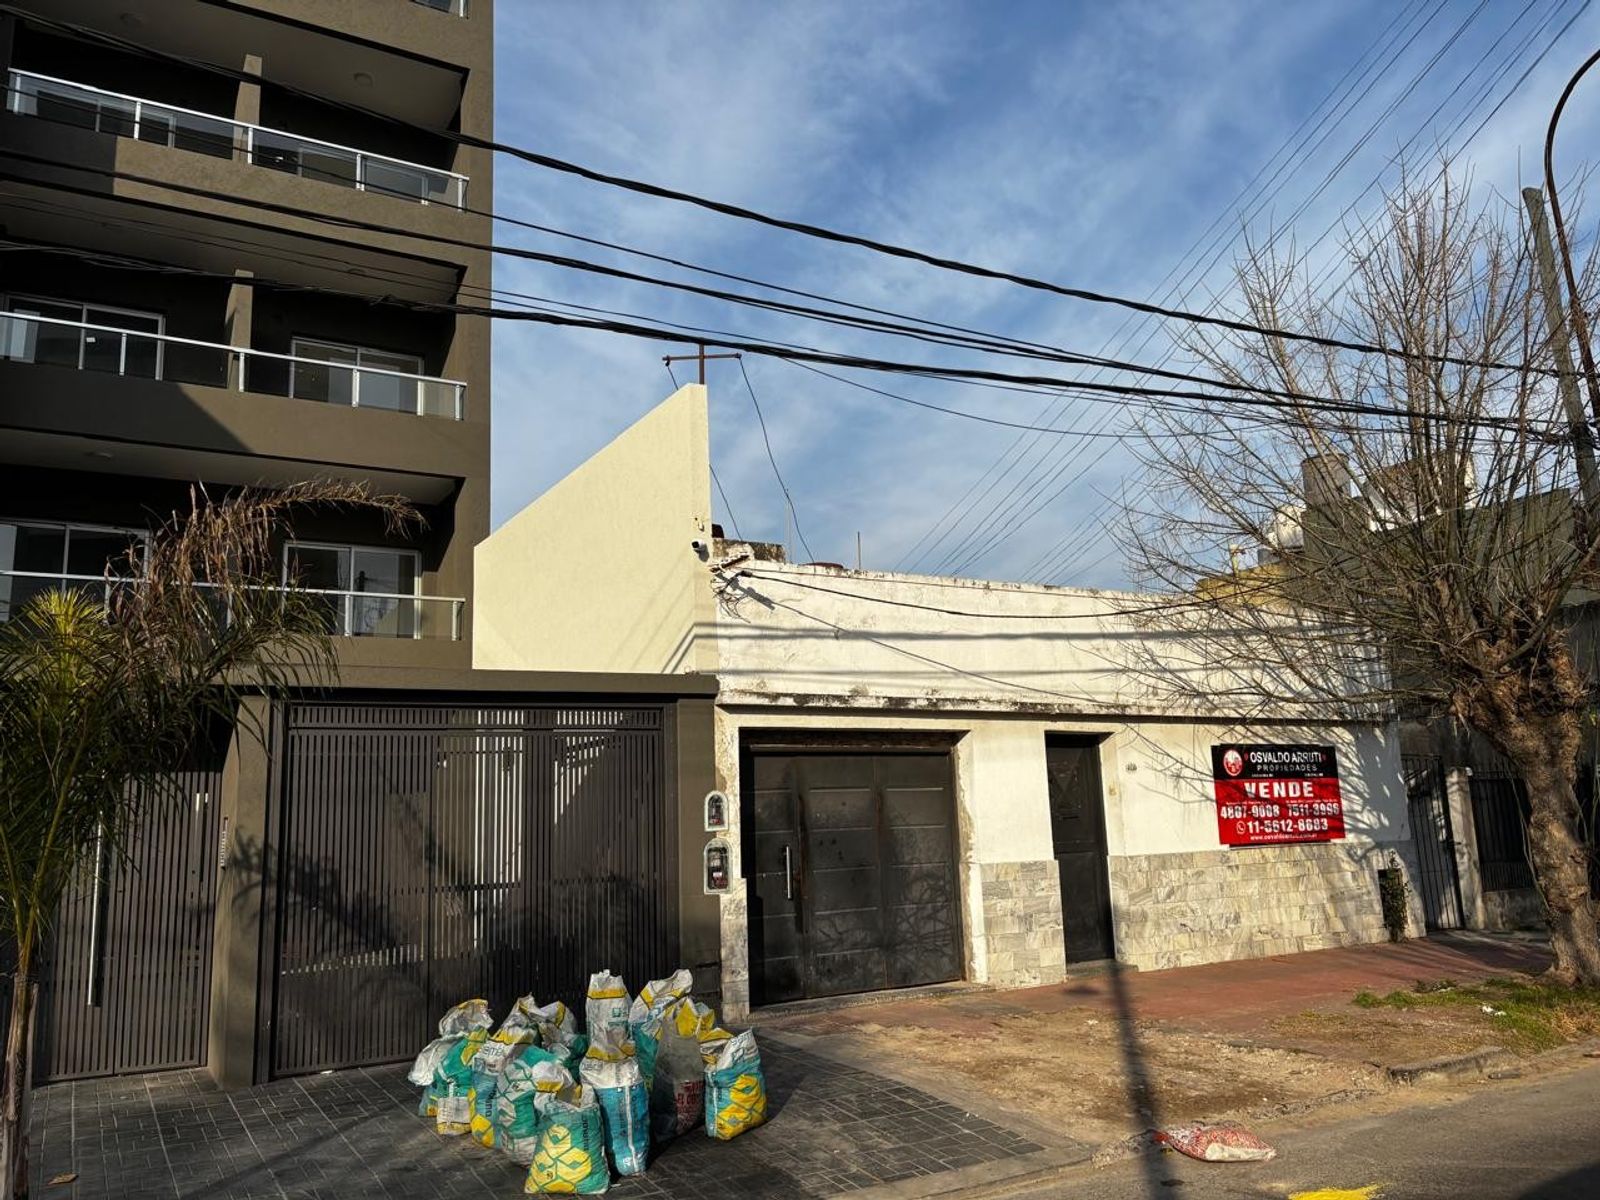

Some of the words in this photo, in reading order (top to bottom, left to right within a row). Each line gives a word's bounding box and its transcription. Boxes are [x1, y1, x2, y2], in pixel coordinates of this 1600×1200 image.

[1250, 752, 1290, 763] OSVALDO
[1292, 752, 1321, 762] ARRUTI
[1244, 782, 1314, 798] VENDE
